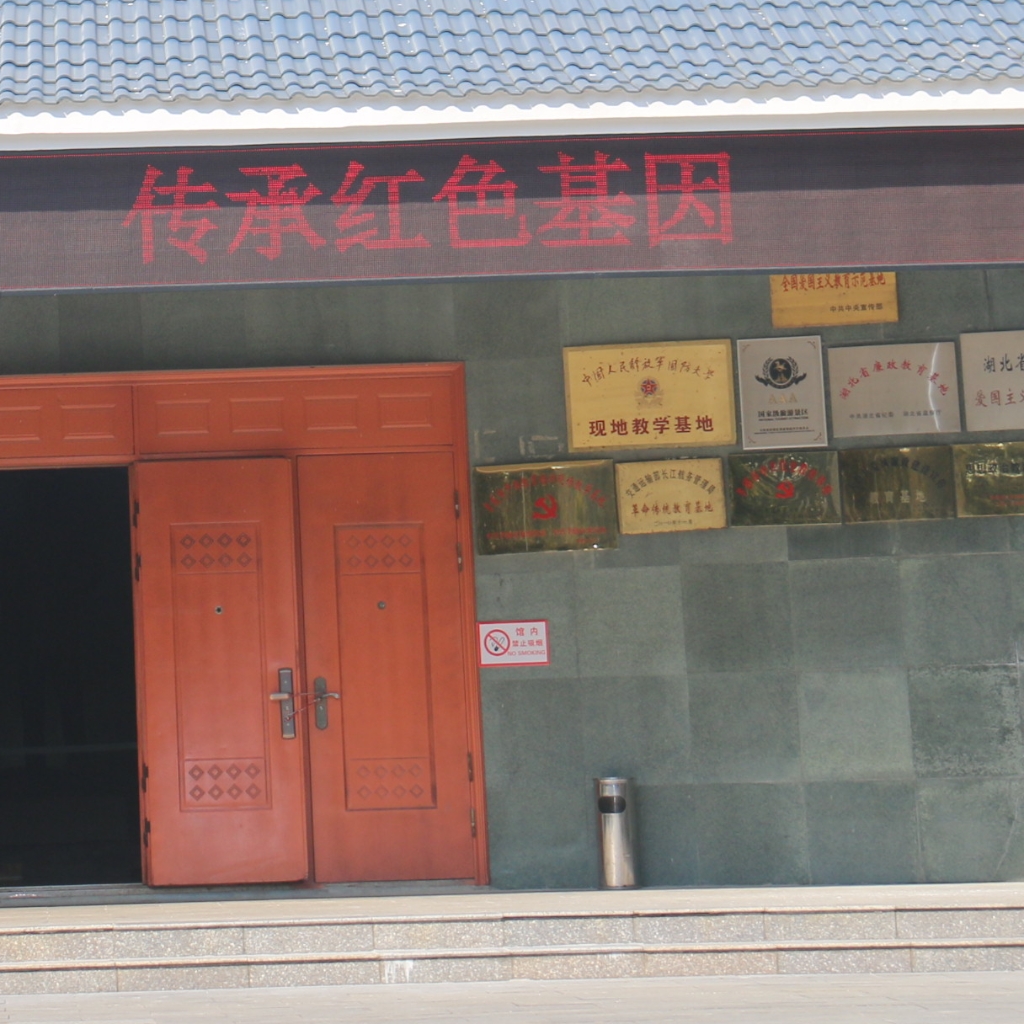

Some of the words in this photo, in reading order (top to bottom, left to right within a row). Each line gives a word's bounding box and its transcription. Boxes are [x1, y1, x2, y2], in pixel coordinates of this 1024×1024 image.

[121, 150, 733, 264] 传承红色基因
[829, 303, 884, 312] 中共中央宣传部
[839, 359, 950, 400] 湖北省廉政教育基地
[768, 392, 798, 404] AAA
[589, 415, 714, 436] 现地教学基地
[631, 500, 714, 516] 革命传统教育基地
[512, 639, 543, 647] 禁止吸烟
